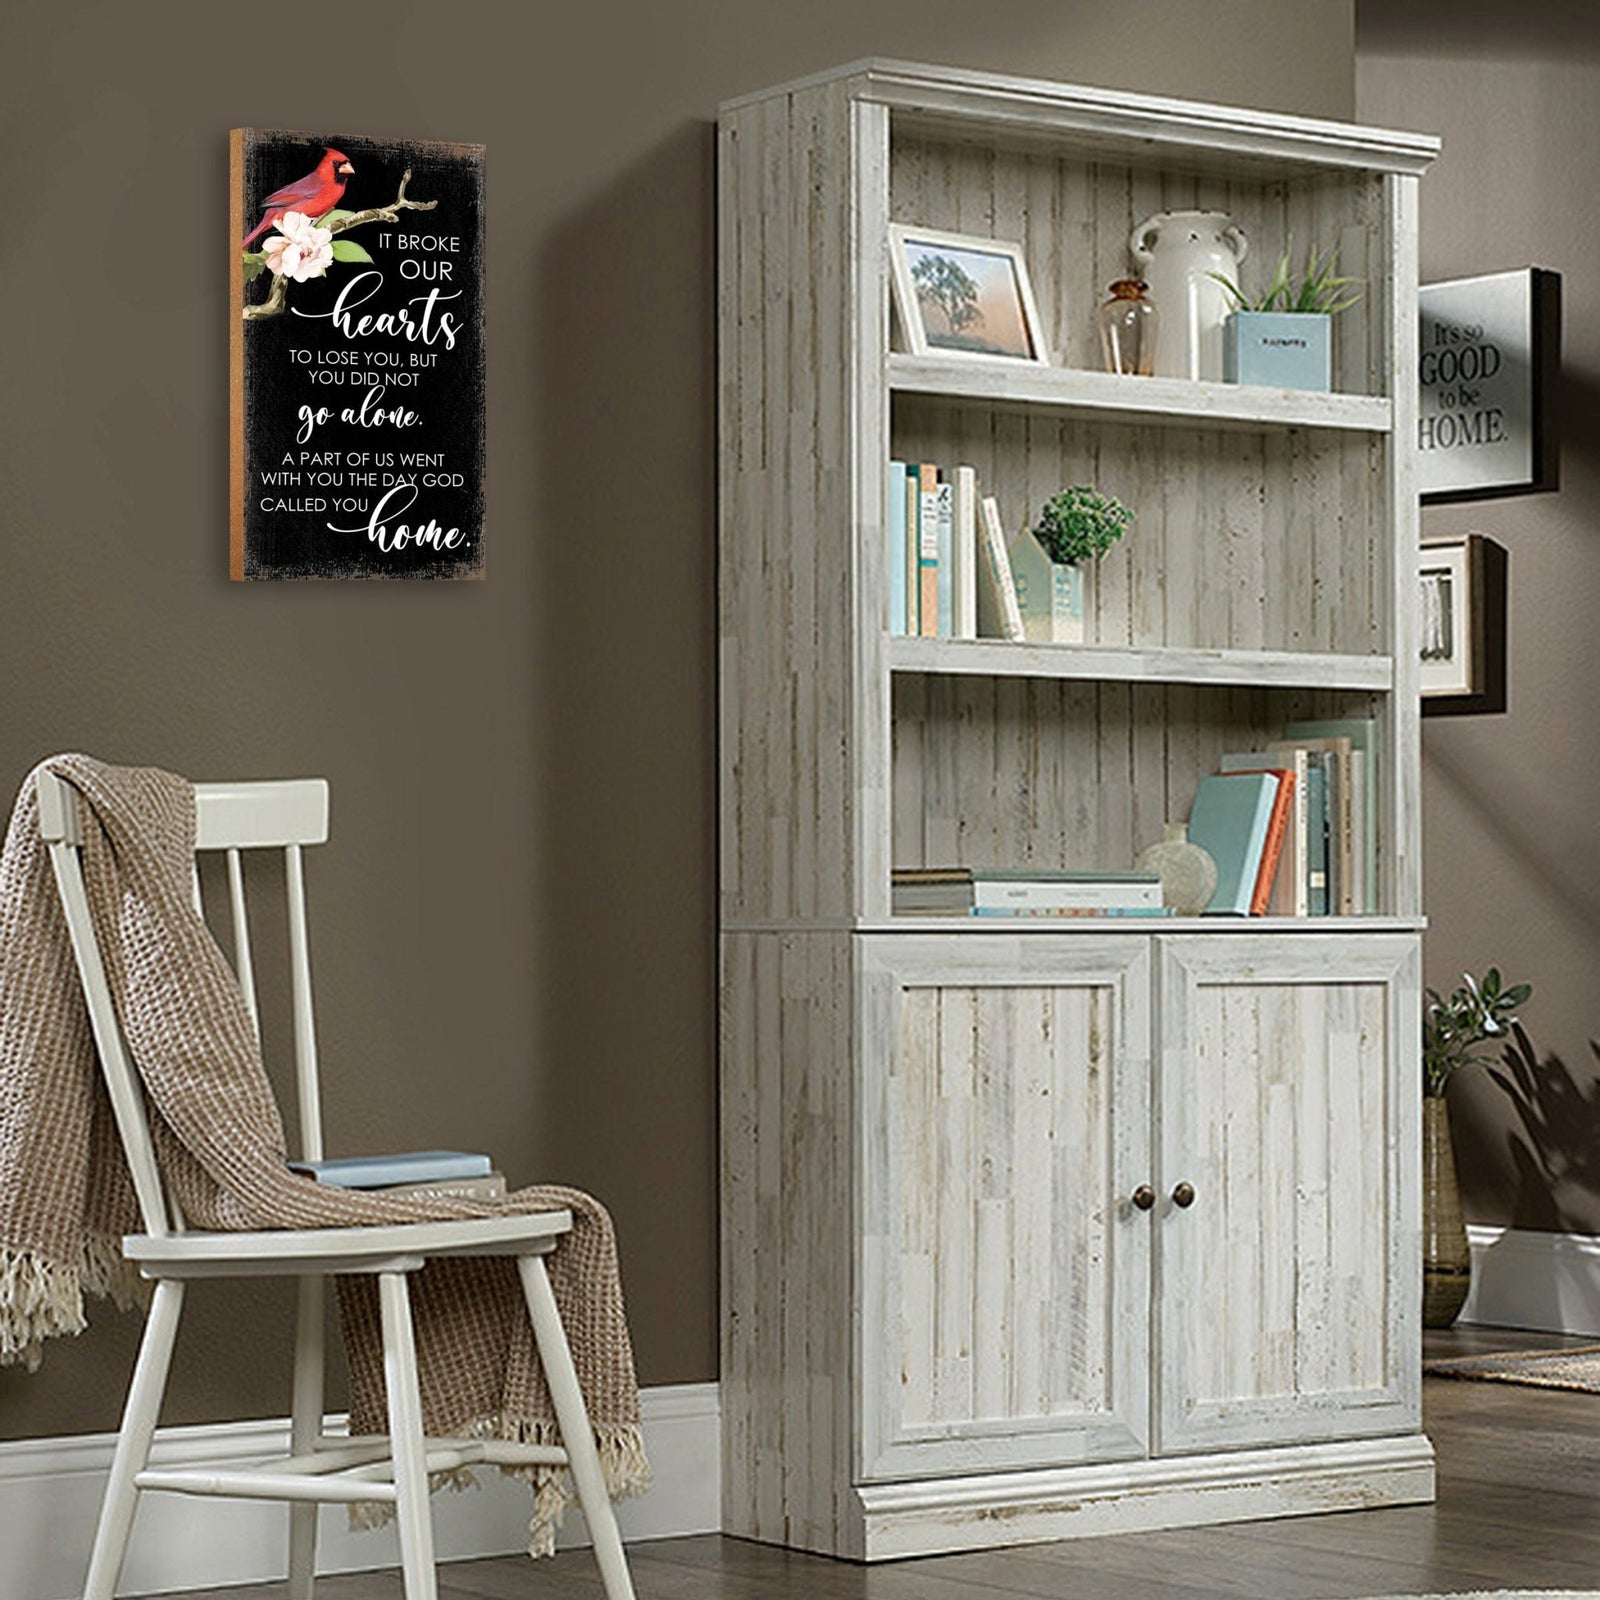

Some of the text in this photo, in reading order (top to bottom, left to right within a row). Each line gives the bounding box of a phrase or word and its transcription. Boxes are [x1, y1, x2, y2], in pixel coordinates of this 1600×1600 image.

[380, 233, 460, 252] IT BROKE
[400, 260, 452, 280] OUR
[291, 271, 463, 350] hearts
[1464, 324, 1484, 342] so
[289, 350, 438, 368] TO LOSE YOU, BUT
[1419, 345, 1500, 386] GOOD
[308, 371, 420, 386] YOU DID NOT
[1439, 385, 1480, 409] to be
[296, 385, 423, 444] go alone.
[1419, 408, 1508, 450] HOME.
[281, 452, 445, 467] A PART OF US WENT
[261, 472, 464, 487] WITH YOU THE DAY GOD
[260, 484, 471, 552] CALLED YOU home.
